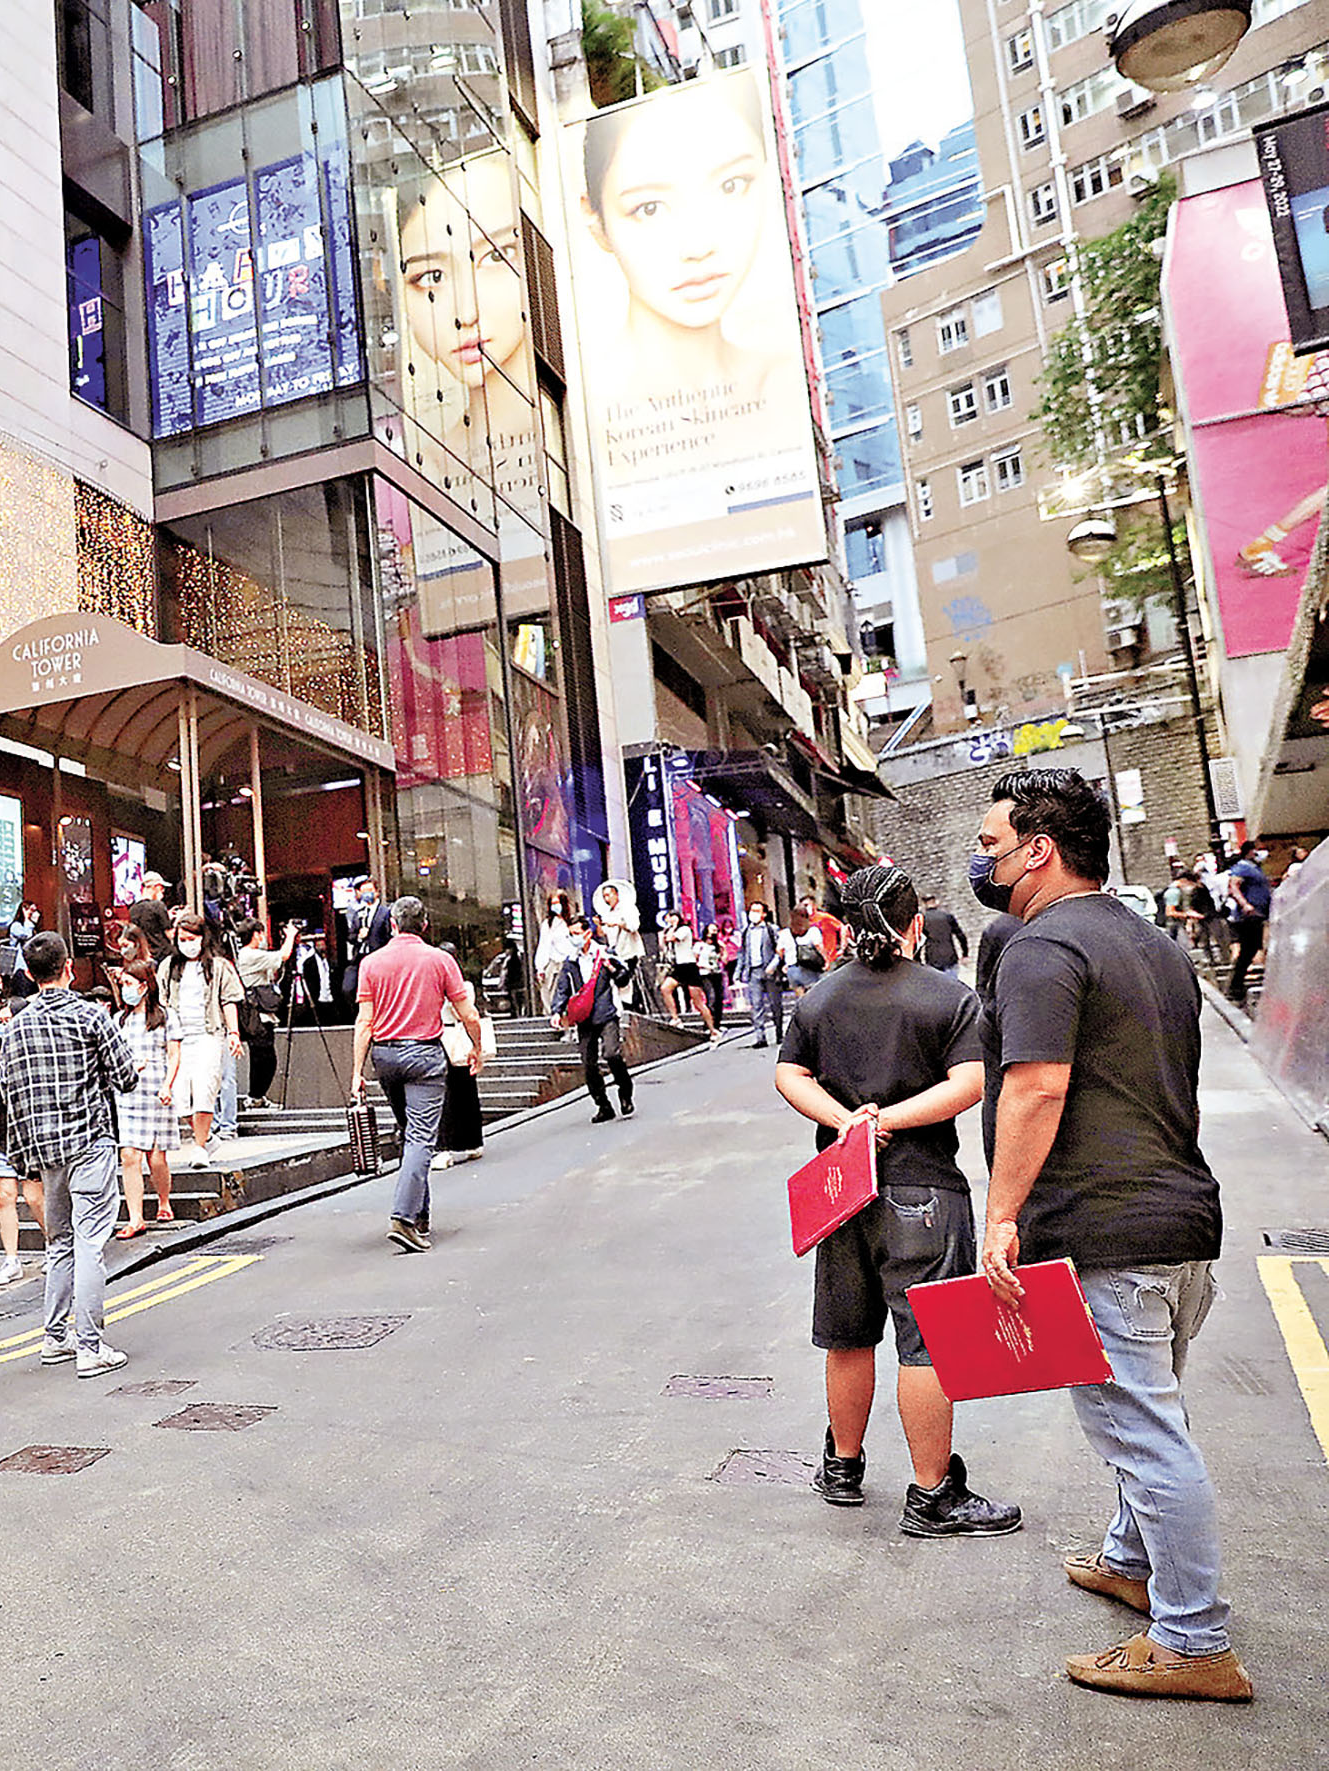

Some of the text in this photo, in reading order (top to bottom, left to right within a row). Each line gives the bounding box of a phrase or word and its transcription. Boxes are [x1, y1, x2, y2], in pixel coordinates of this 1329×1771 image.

[605, 420, 675, 445] Korean
[607, 433, 716, 467] Experience
[13, 627, 99, 661] CALIFORNIA
[31, 652, 81, 678] TOWER
[644, 756, 663, 827] LIE
